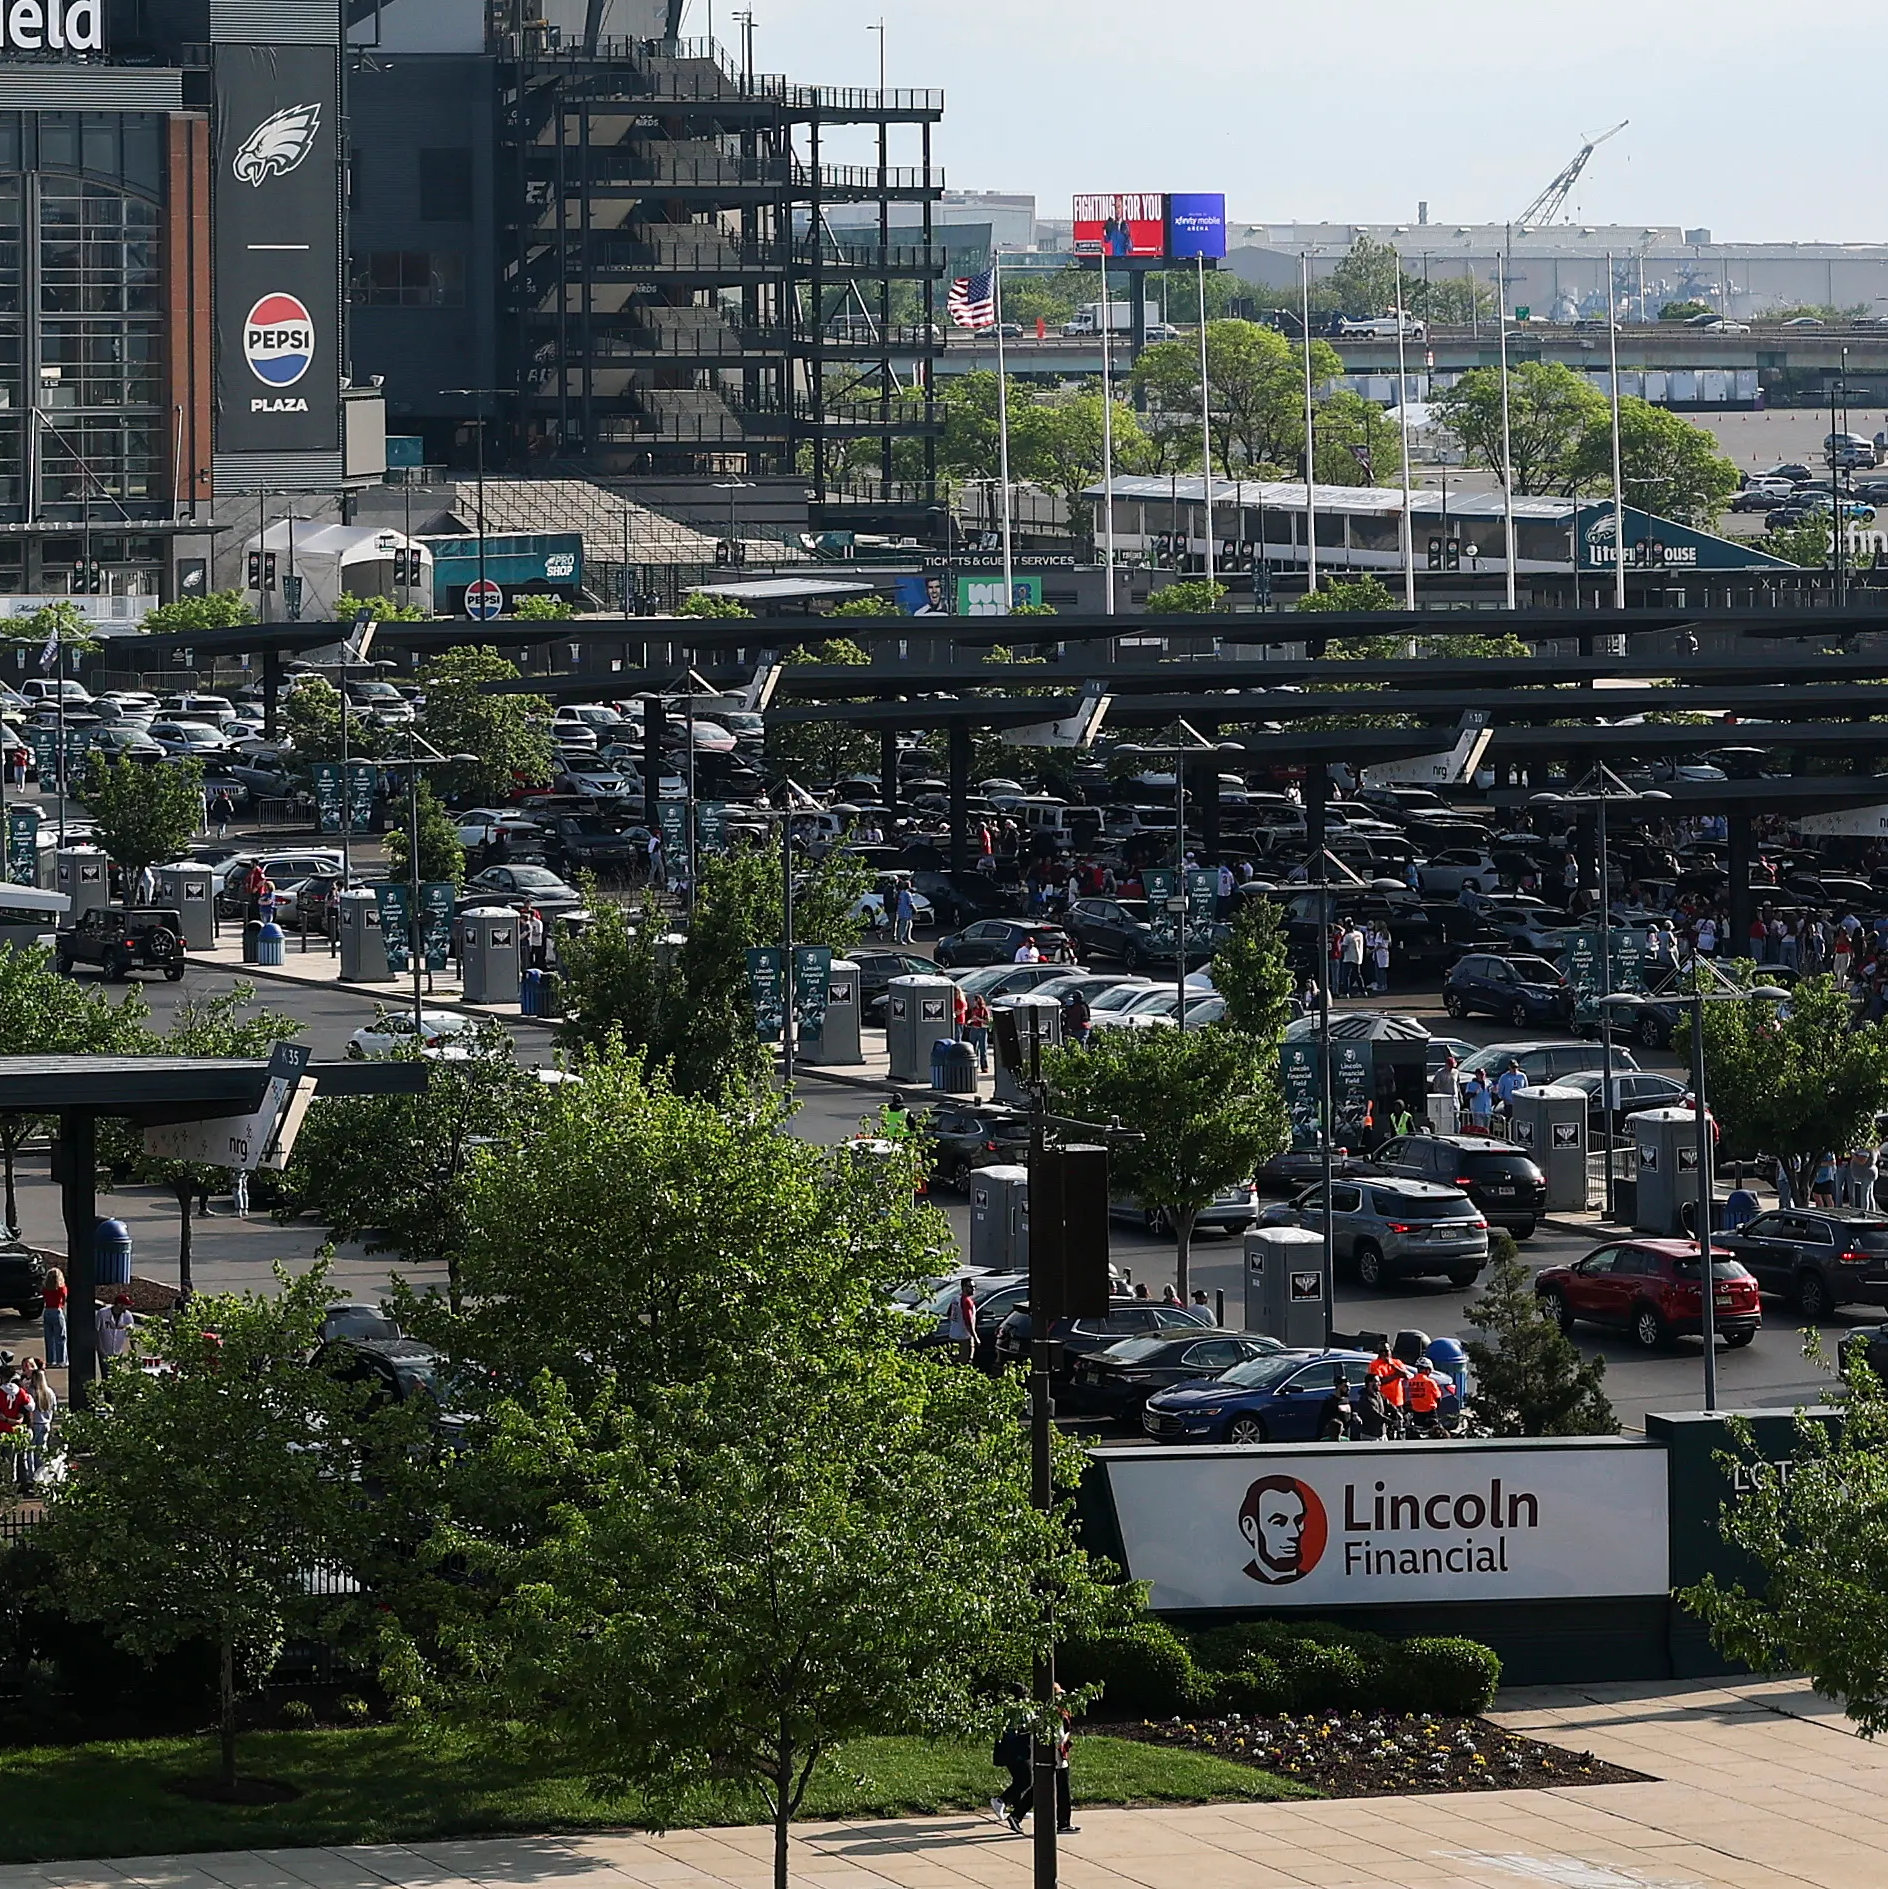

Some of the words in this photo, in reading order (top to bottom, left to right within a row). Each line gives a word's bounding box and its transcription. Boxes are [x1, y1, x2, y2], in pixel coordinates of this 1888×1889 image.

[1075, 195, 1116, 221] FIGHTING
[1123, 195, 1140, 221] FOR
[1142, 195, 1162, 221] YOU
[249, 330, 310, 349] PEPSI
[251, 398, 309, 412] PLAZA
[123, 519, 215, 529] OFFICE
[553, 554, 575, 565] PRO
[1021, 556, 1075, 566] SERVICES
[546, 565, 574, 577] SHOP
[1761, 577, 1870, 590] XFINITY
[1433, 765, 1448, 780] nrg
[229, 1139, 248, 1163] nrg
[1344, 1478, 1538, 1531] Lincoln
[1344, 1536, 1509, 1576] Financial
